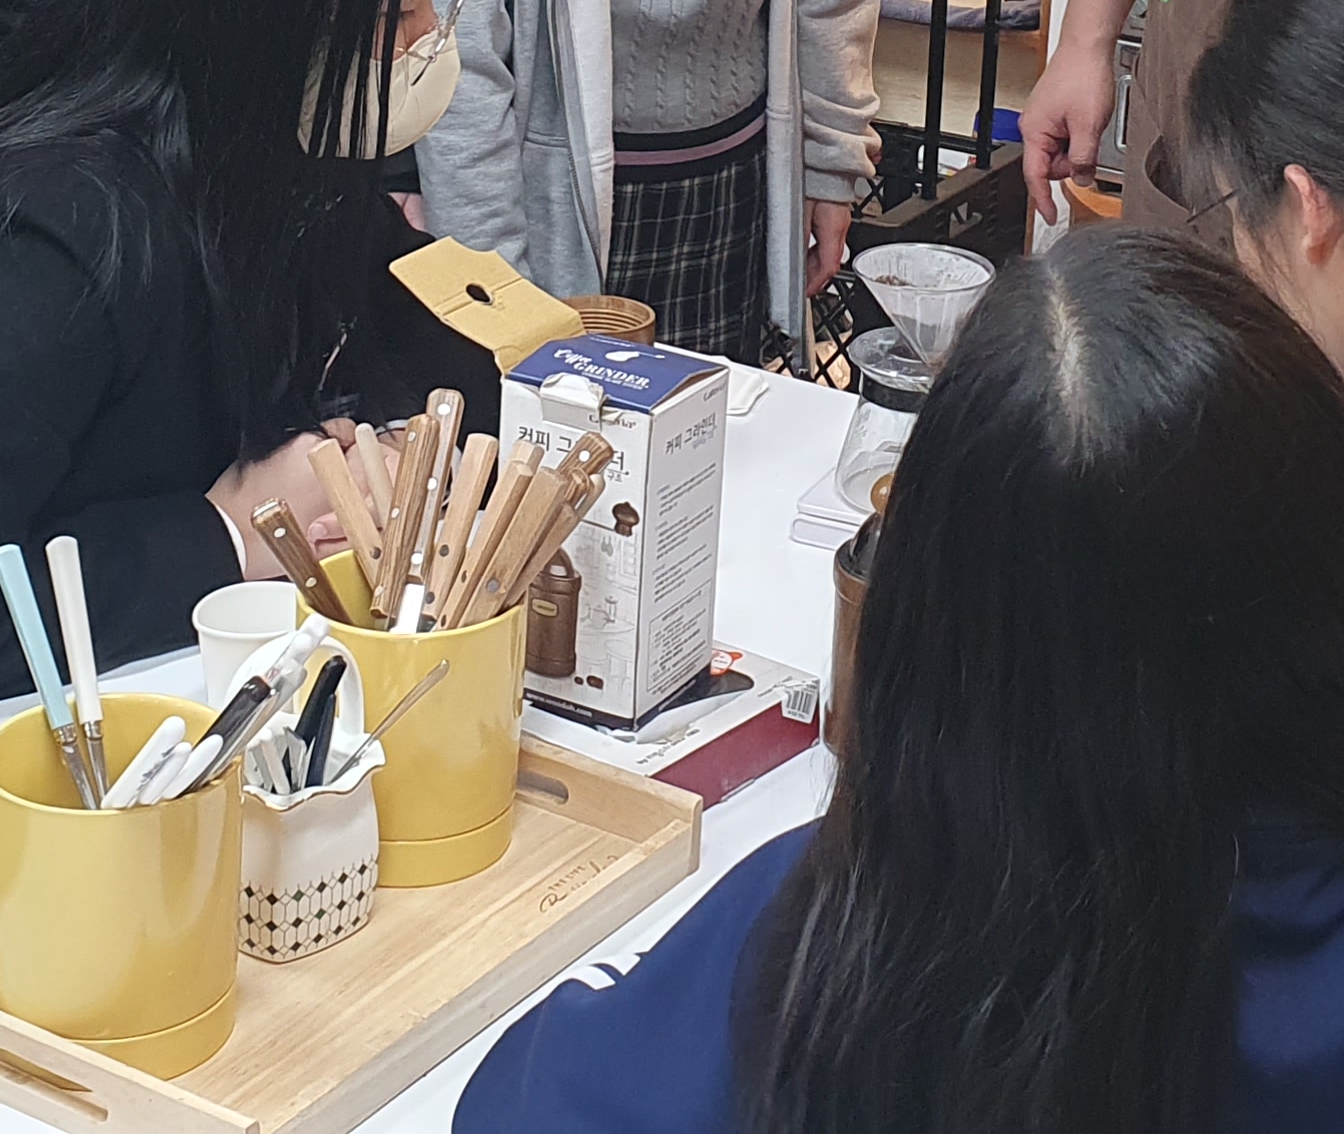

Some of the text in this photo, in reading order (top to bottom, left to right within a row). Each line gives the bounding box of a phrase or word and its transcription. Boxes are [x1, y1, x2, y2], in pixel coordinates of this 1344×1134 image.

[518, 426, 551, 452] 커피
[665, 412, 717, 456] 커피 그라인더
